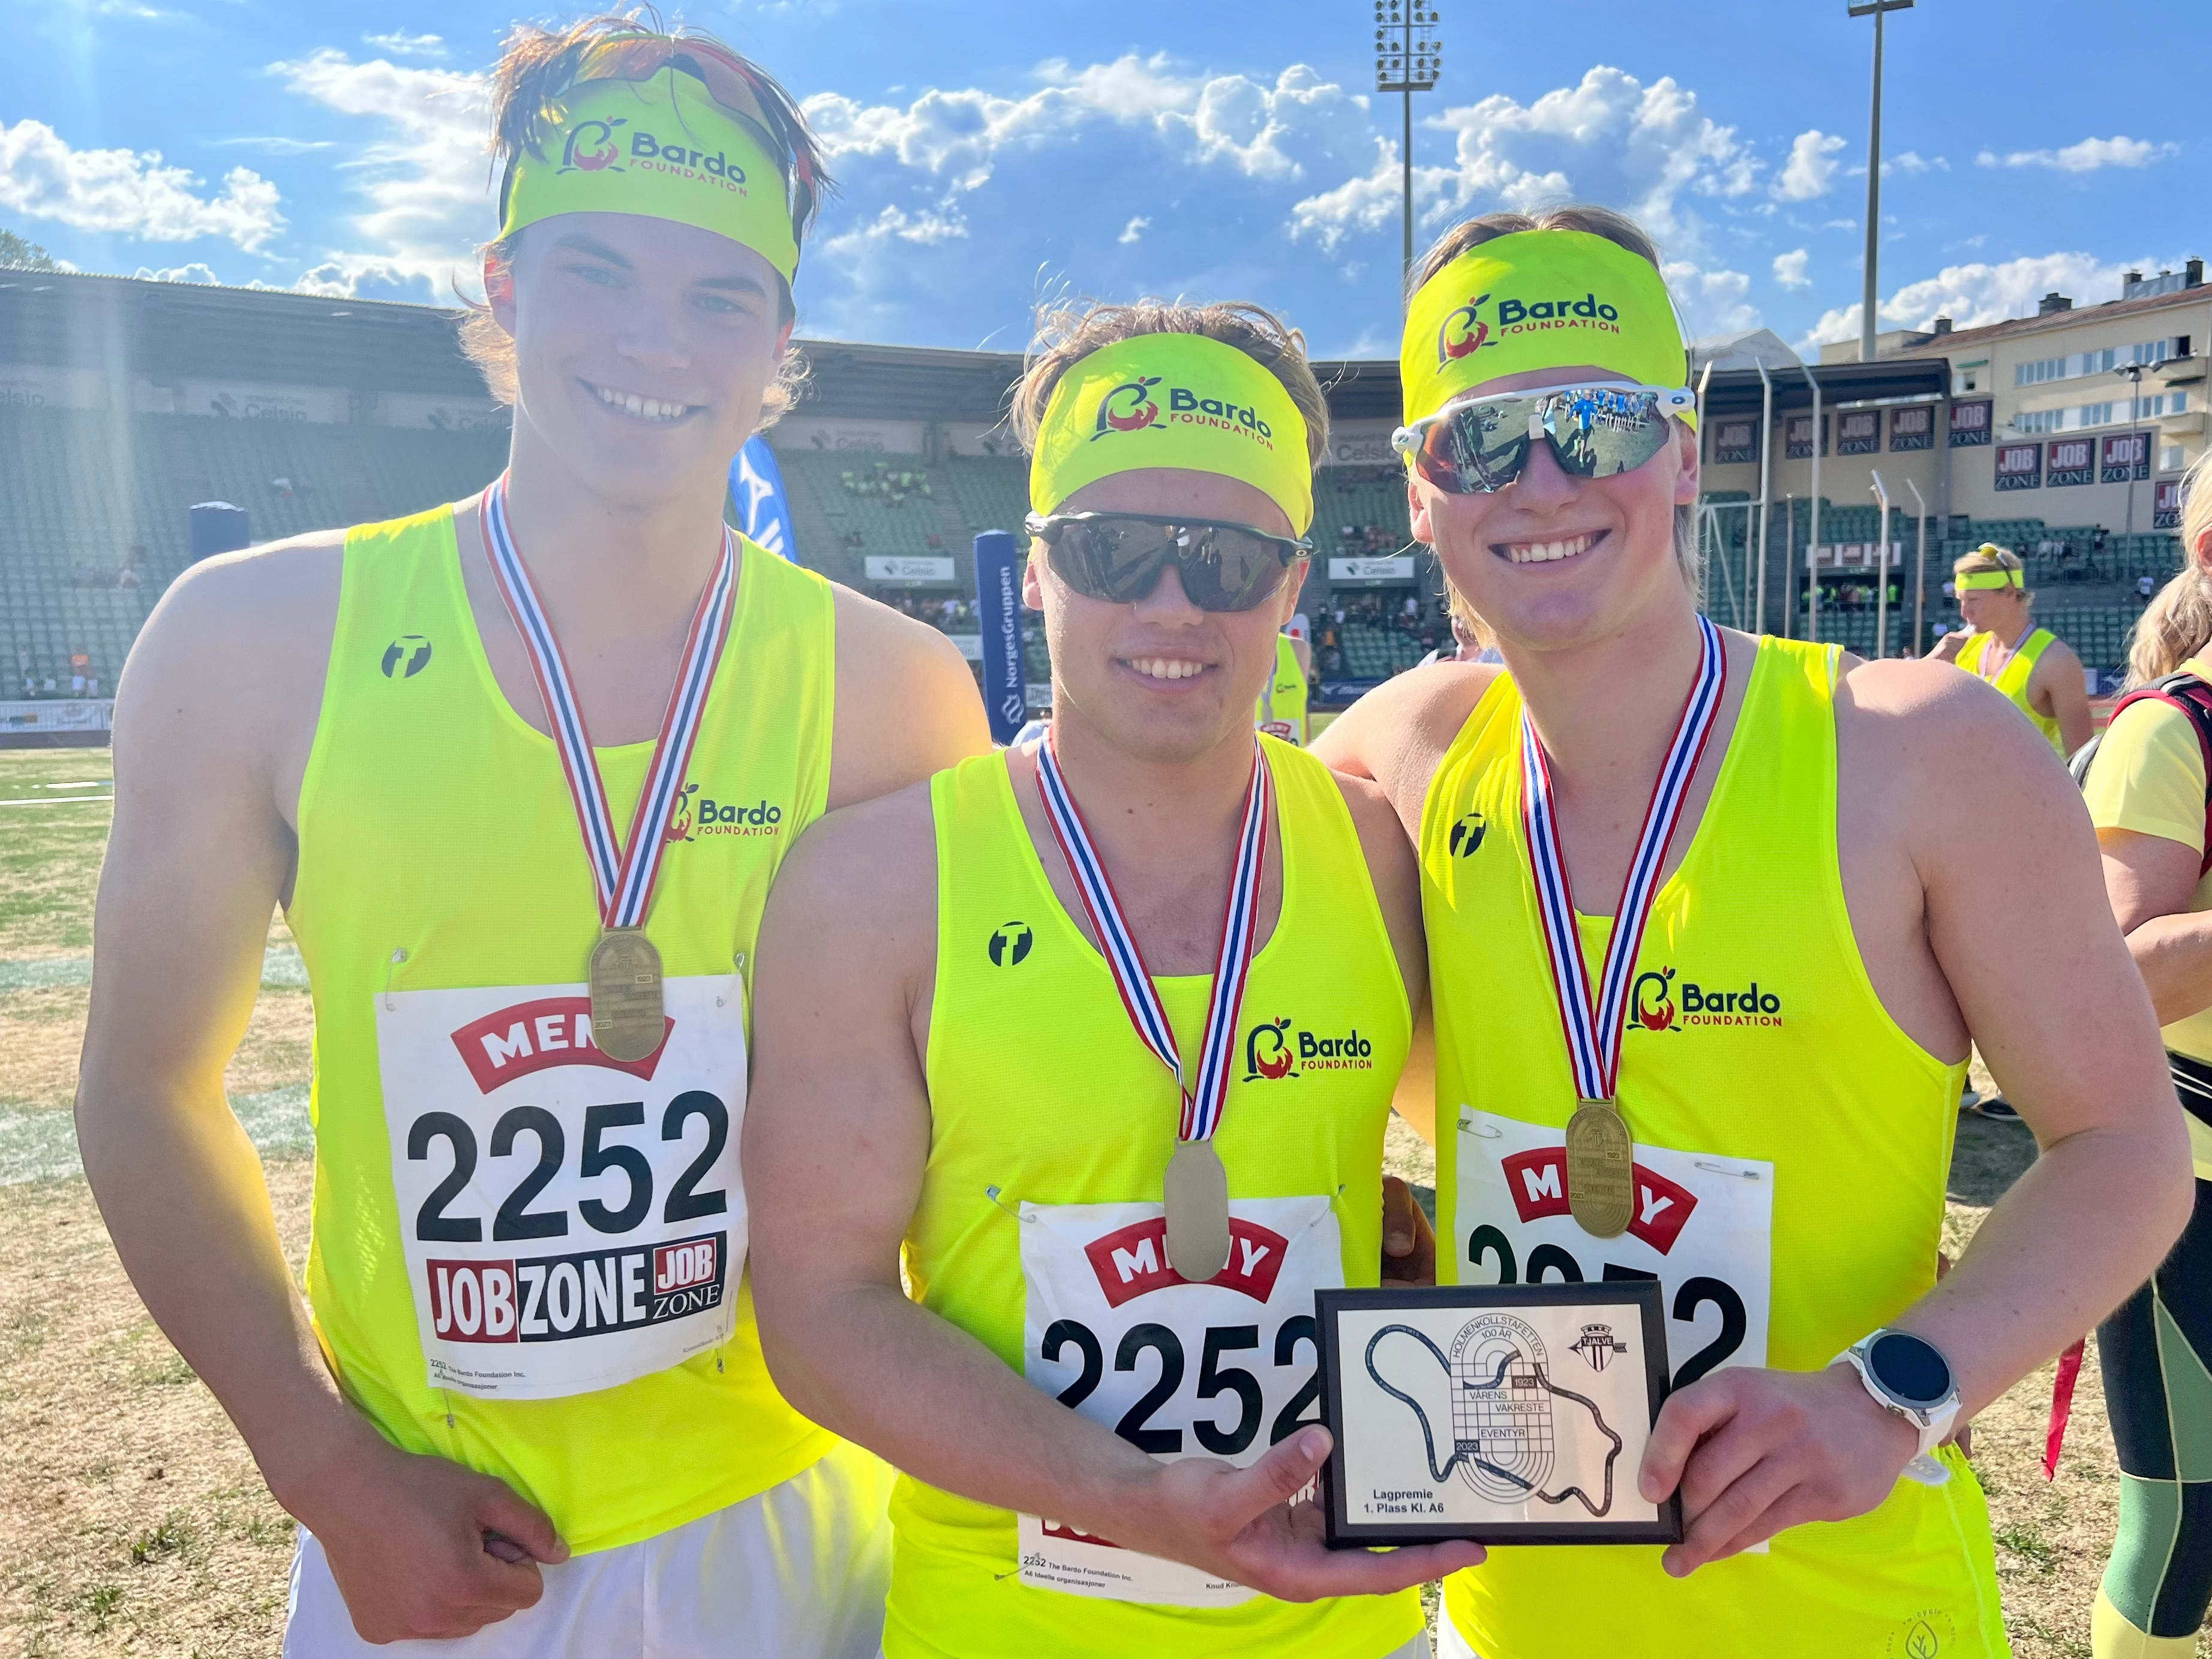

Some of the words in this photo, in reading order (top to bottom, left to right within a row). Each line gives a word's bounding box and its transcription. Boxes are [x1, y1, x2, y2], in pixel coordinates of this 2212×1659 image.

[631, 132, 746, 184] Bardo
[630, 158, 748, 197] FOUNDATION
[1499, 293, 1618, 326] Bardo
[1500, 319, 1620, 337] FOUNDATION
[1170, 389, 1272, 438] Bardo
[1893, 411, 1926, 434] JOB
[1951, 406, 1984, 429] JOB
[1170, 413, 1273, 451] FOUNDATION
[1891, 436, 1932, 449] ZONE
[1949, 431, 1990, 445] ZONE
[1838, 441, 1878, 452] ZONE
[2052, 443, 2087, 469] JOB
[2106, 439, 2142, 464] JOB
[2000, 449, 2034, 472] JOB
[1997, 475, 2039, 489] ZONE
[2049, 470, 2093, 485] ZONE
[1001, 566, 1019, 688] NorgesGruppen
[698, 800, 781, 826] Bardo
[697, 826, 779, 836] FOUNDATION
[1682, 983, 1780, 1014] Bardo
[1683, 1015, 1782, 1027] FOUNDATION
[481, 1013, 600, 1069] MEN
[1298, 1030, 1371, 1058] Bardo
[1301, 1060, 1372, 1070] FOUNDATION
[407, 1090, 729, 1242] 2252
[658, 1244, 713, 1289] JOB
[1111, 1237, 1270, 1284] MY
[653, 1283, 720, 1319] ZONE
[1452, 1316, 1544, 1358] HOLMENKOLLSTAFETTEN
[1481, 1328, 1497, 1339] 100
[1499, 1327, 1512, 1339] ÅR
[430, 1358, 447, 1370] 2252
[1042, 1315, 1320, 1455] 2252
[1470, 1388, 1508, 1400] VÅRENS
[1515, 1378, 1534, 1387] 1923
[1495, 1403, 1544, 1412] VAKRESTE
[1481, 1429, 1526, 1438] EVENTYR
[1456, 1442, 1479, 1451] 2023
[1373, 1489, 1433, 1501] Lagpremie
[1364, 1502, 1374, 1513] 1.
[1377, 1503, 1407, 1513] Plass
[1429, 1502, 1445, 1513] A6
[1049, 1562, 1061, 1570] The
[1062, 1564, 1082, 1573] Bardo
[1083, 1567, 1121, 1579] Foundation
[1057, 1576, 1106, 1588] organisasjoner
